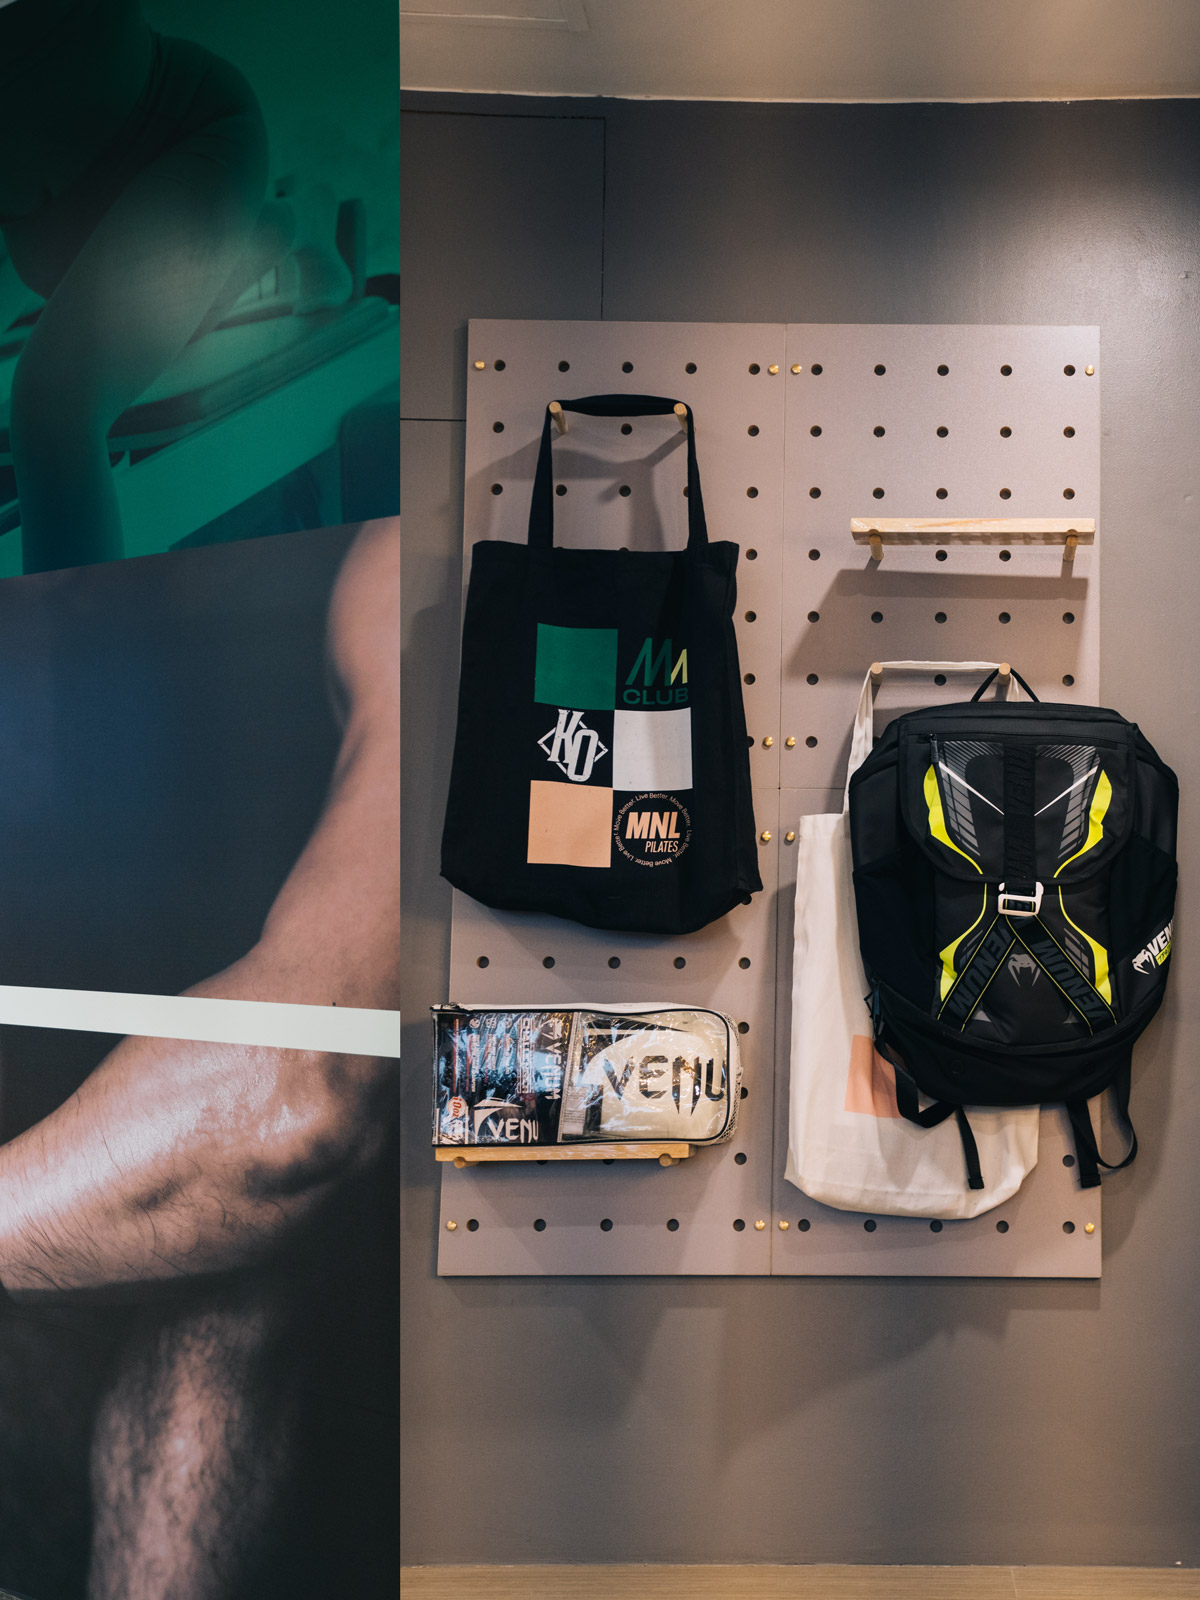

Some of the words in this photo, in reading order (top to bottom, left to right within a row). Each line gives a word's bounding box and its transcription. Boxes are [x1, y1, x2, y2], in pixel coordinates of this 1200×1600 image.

[623, 687, 689, 706] CLUB
[546, 708, 599, 782] KO
[625, 811, 681, 839] MNL
[644, 840, 679, 853] PILATES
[1146, 918, 1173, 957] VEN
[949, 925, 1013, 1016] VENUM
[1031, 939, 1112, 1022] VENUM
[541, 1042, 562, 1100] VENUM
